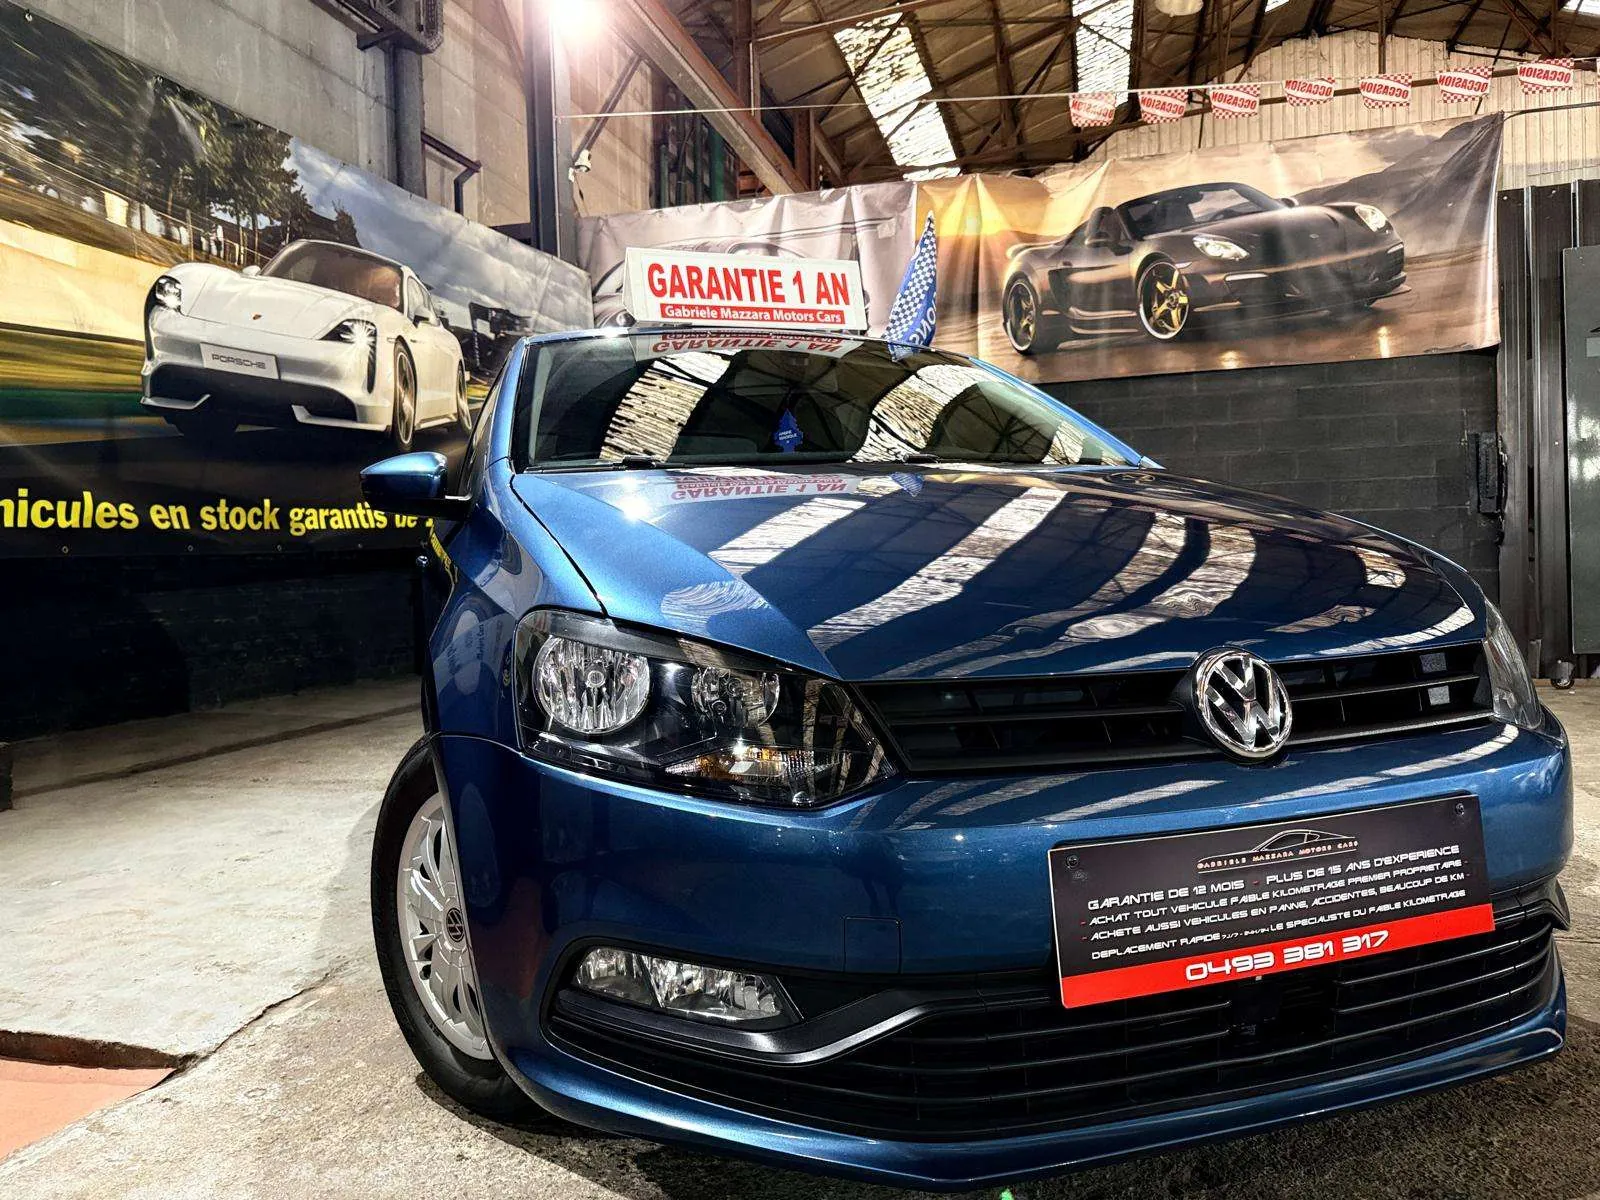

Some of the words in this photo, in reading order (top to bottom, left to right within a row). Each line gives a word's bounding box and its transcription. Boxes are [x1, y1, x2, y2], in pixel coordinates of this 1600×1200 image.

[647, 263, 786, 303] GARANTIE
[792, 270, 805, 303] 1
[816, 272, 850, 306] AN
[665, 304, 718, 319] Gabriele
[719, 307, 770, 321] Mazzara
[772, 309, 815, 322] Motors
[816, 310, 841, 323] Cars
[211, 353, 267, 370] PORSCHE
[149, 504, 191, 530] en
[199, 498, 281, 531] stock
[289, 501, 388, 537] garantis
[1266, 870, 1303, 885] PLUS
[1306, 867, 1325, 878] DE
[1327, 864, 1342, 875] 15
[1345, 859, 1371, 873] ANS
[1374, 845, 1460, 867] D'EXPERIENCE
[1087, 890, 1165, 911] GARANTIE
[1168, 887, 1190, 899] DE
[1193, 885, 1207, 895] 12
[1210, 879, 1245, 893] MOIS
[1089, 912, 1131, 926] ACHAT
[1134, 907, 1168, 919] TOUT
[1171, 897, 1228, 914] VEHICULE
[1230, 891, 1270, 906] FAIBLE
[1272, 879, 1345, 899] KILOMETRAGE
[1347, 871, 1391, 886] PREMIER
[1393, 859, 1462, 878] PROPRIETAIRE
[1090, 925, 1142, 941] ACHETE
[1145, 920, 1181, 933] AUSSI
[1184, 909, 1248, 927] VEHICULES
[1250, 905, 1267, 917] EN
[1269, 900, 1309, 913] PANNE,
[1380, 877, 1433, 894] BEAUCOUP
[1435, 876, 1448, 884] DE
[1450, 872, 1465, 882] KM
[1091, 939, 1178, 960] DEPLACEMENT
[1180, 932, 1221, 946] RAPIDE
[1270, 923, 1284, 931] LE
[1352, 908, 1367, 917] DU
[1368, 901, 1402, 914] FAIBLE
[1403, 889, 1466, 908] KILOMETRAGE
[1185, 951, 1275, 982] 0493
[1282, 940, 1335, 964] 381
[1342, 930, 1389, 954] 317
